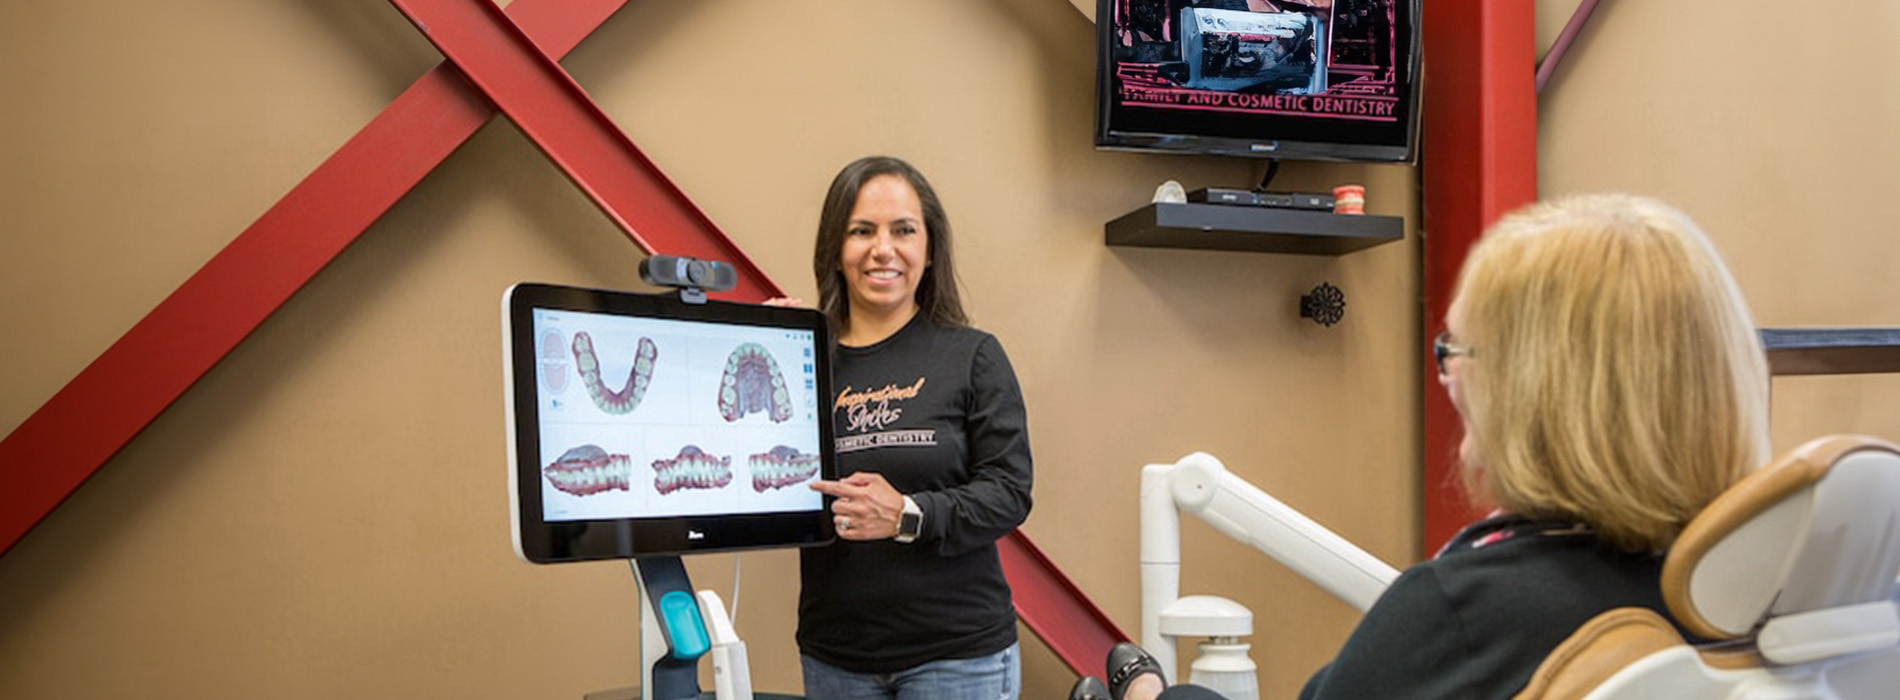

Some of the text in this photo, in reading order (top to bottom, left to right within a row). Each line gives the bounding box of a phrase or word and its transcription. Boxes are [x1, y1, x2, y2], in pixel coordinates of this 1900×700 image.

[1187, 93, 1223, 106] AND
[1228, 94, 1308, 111] COSMETIC
[1312, 97, 1395, 116] DENTISTRY
[877, 431, 936, 444] DENTISTRY
